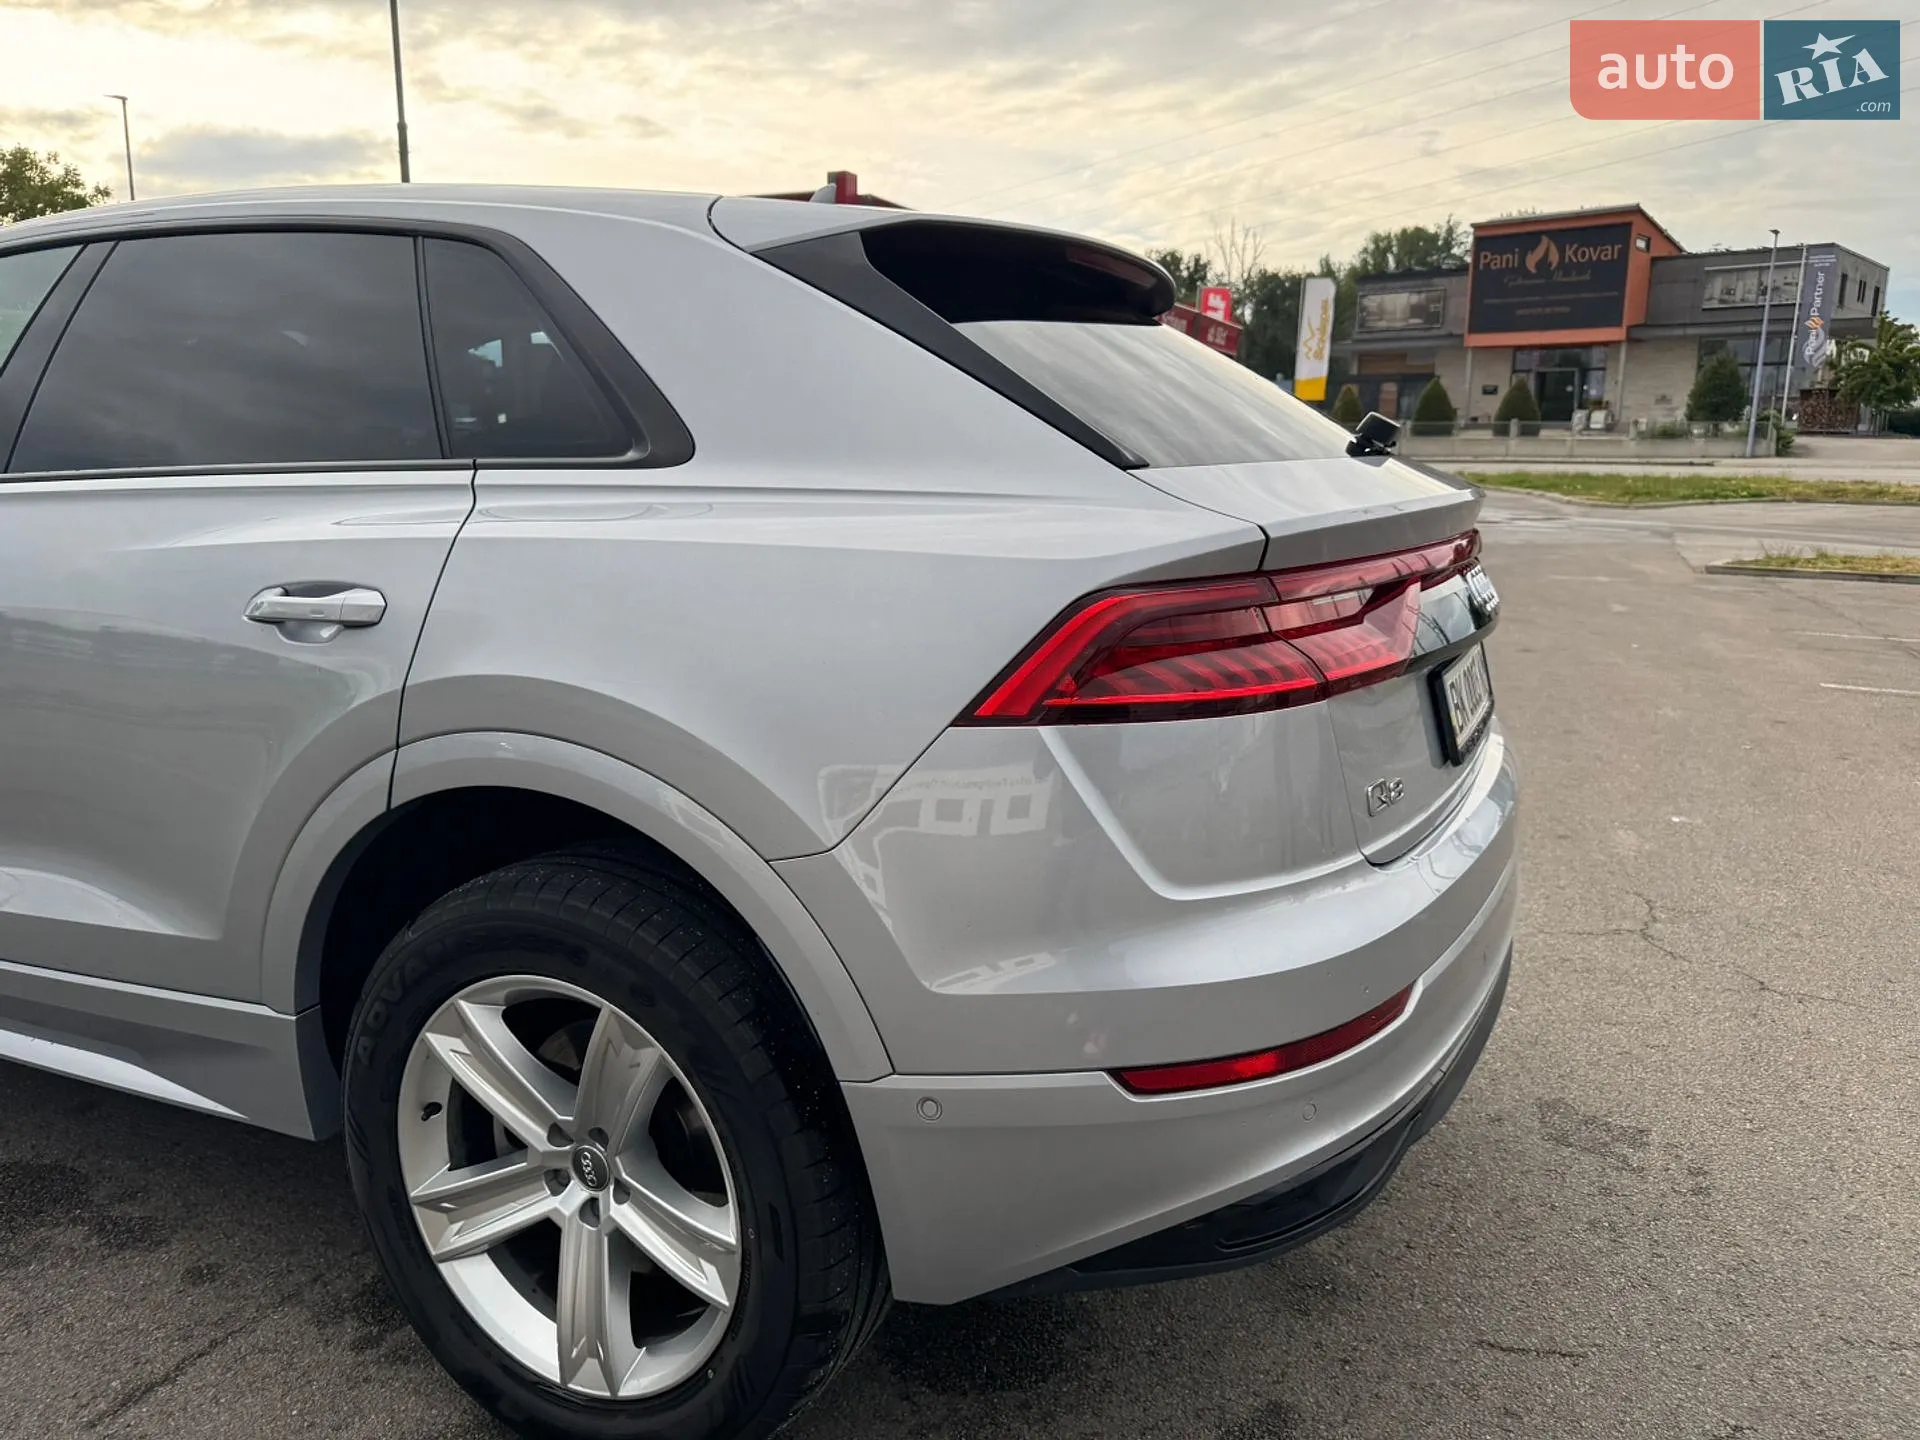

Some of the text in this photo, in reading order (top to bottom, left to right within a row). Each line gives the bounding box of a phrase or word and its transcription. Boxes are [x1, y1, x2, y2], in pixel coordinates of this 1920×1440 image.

[1479, 242, 1623, 271] Pani Kovar
[1809, 271, 1826, 317] Partner
[1804, 329, 1818, 356] Pani
